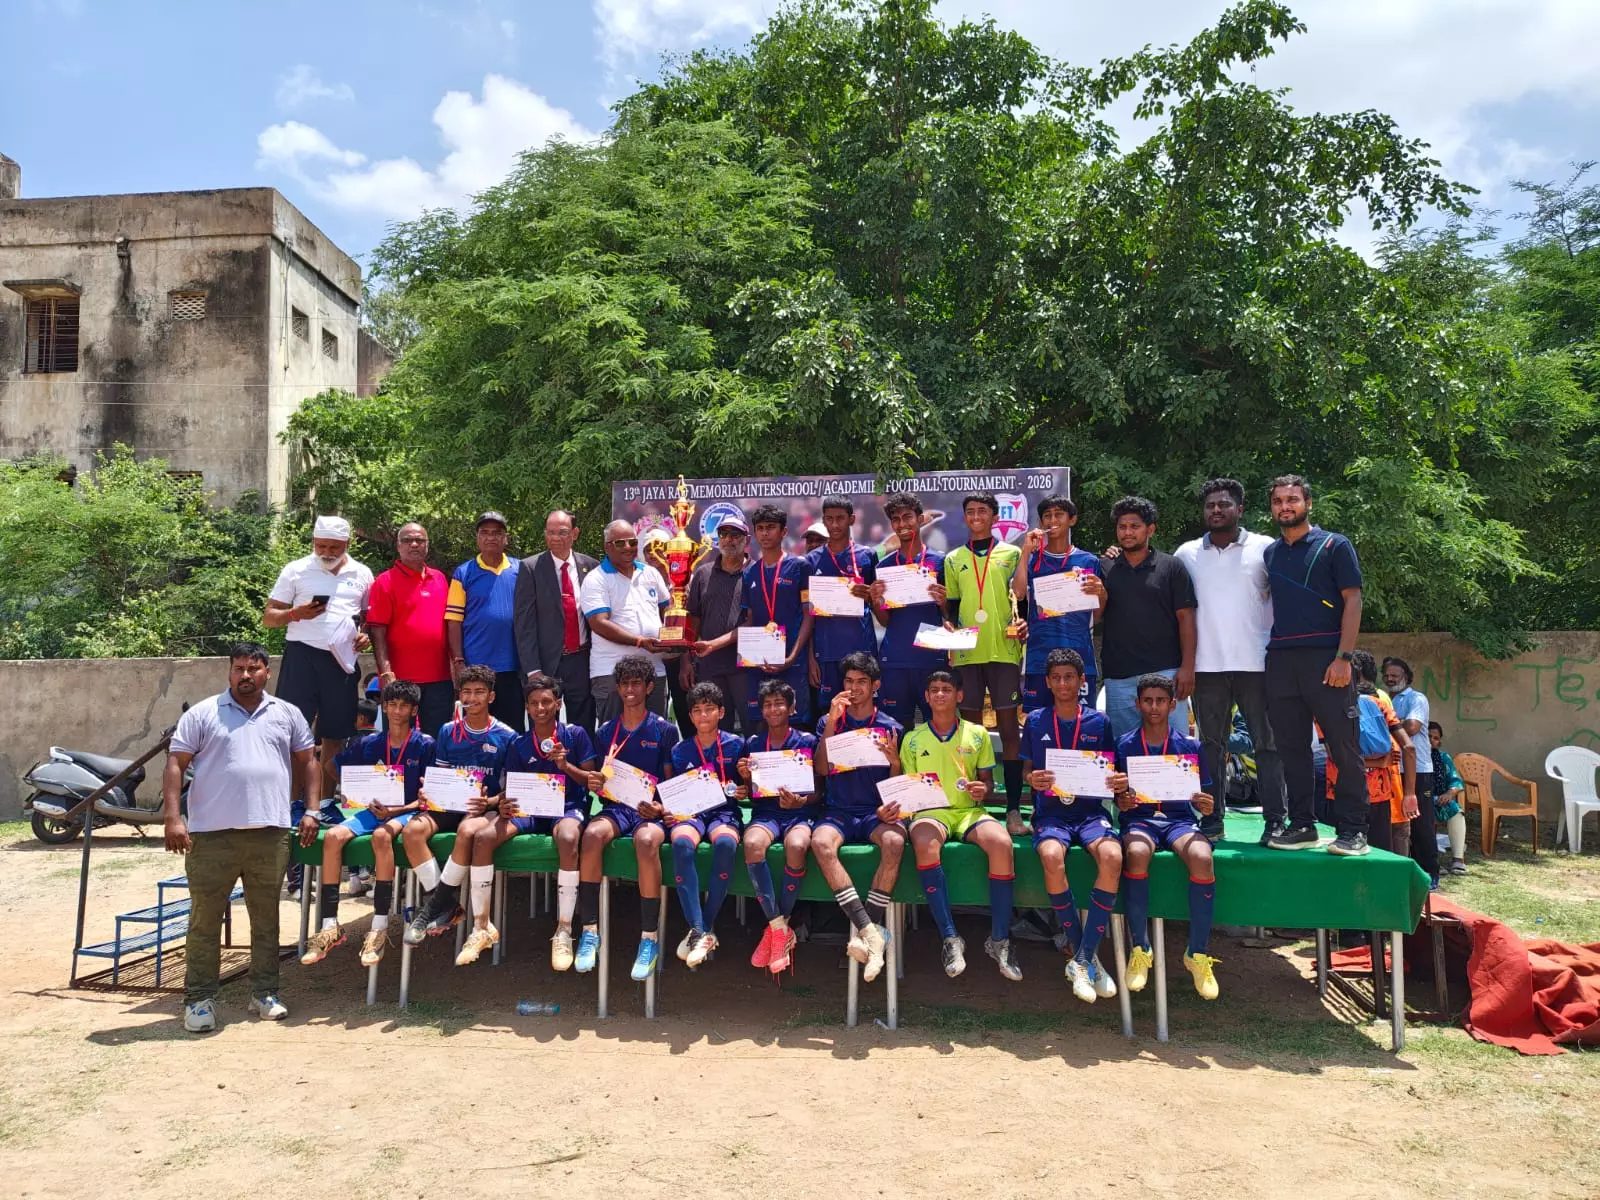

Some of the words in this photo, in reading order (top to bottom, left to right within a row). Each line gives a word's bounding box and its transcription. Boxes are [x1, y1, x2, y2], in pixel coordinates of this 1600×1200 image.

[624, 487, 641, 500] 13th
[642, 486, 666, 503] JAYA
[690, 483, 744, 499] MEMORIAL
[746, 481, 816, 497] INTERSCHOOL
[886, 478, 939, 493] FOOTBALL
[941, 475, 1016, 491] TOURNAMENT
[1027, 474, 1052, 490] 2026
